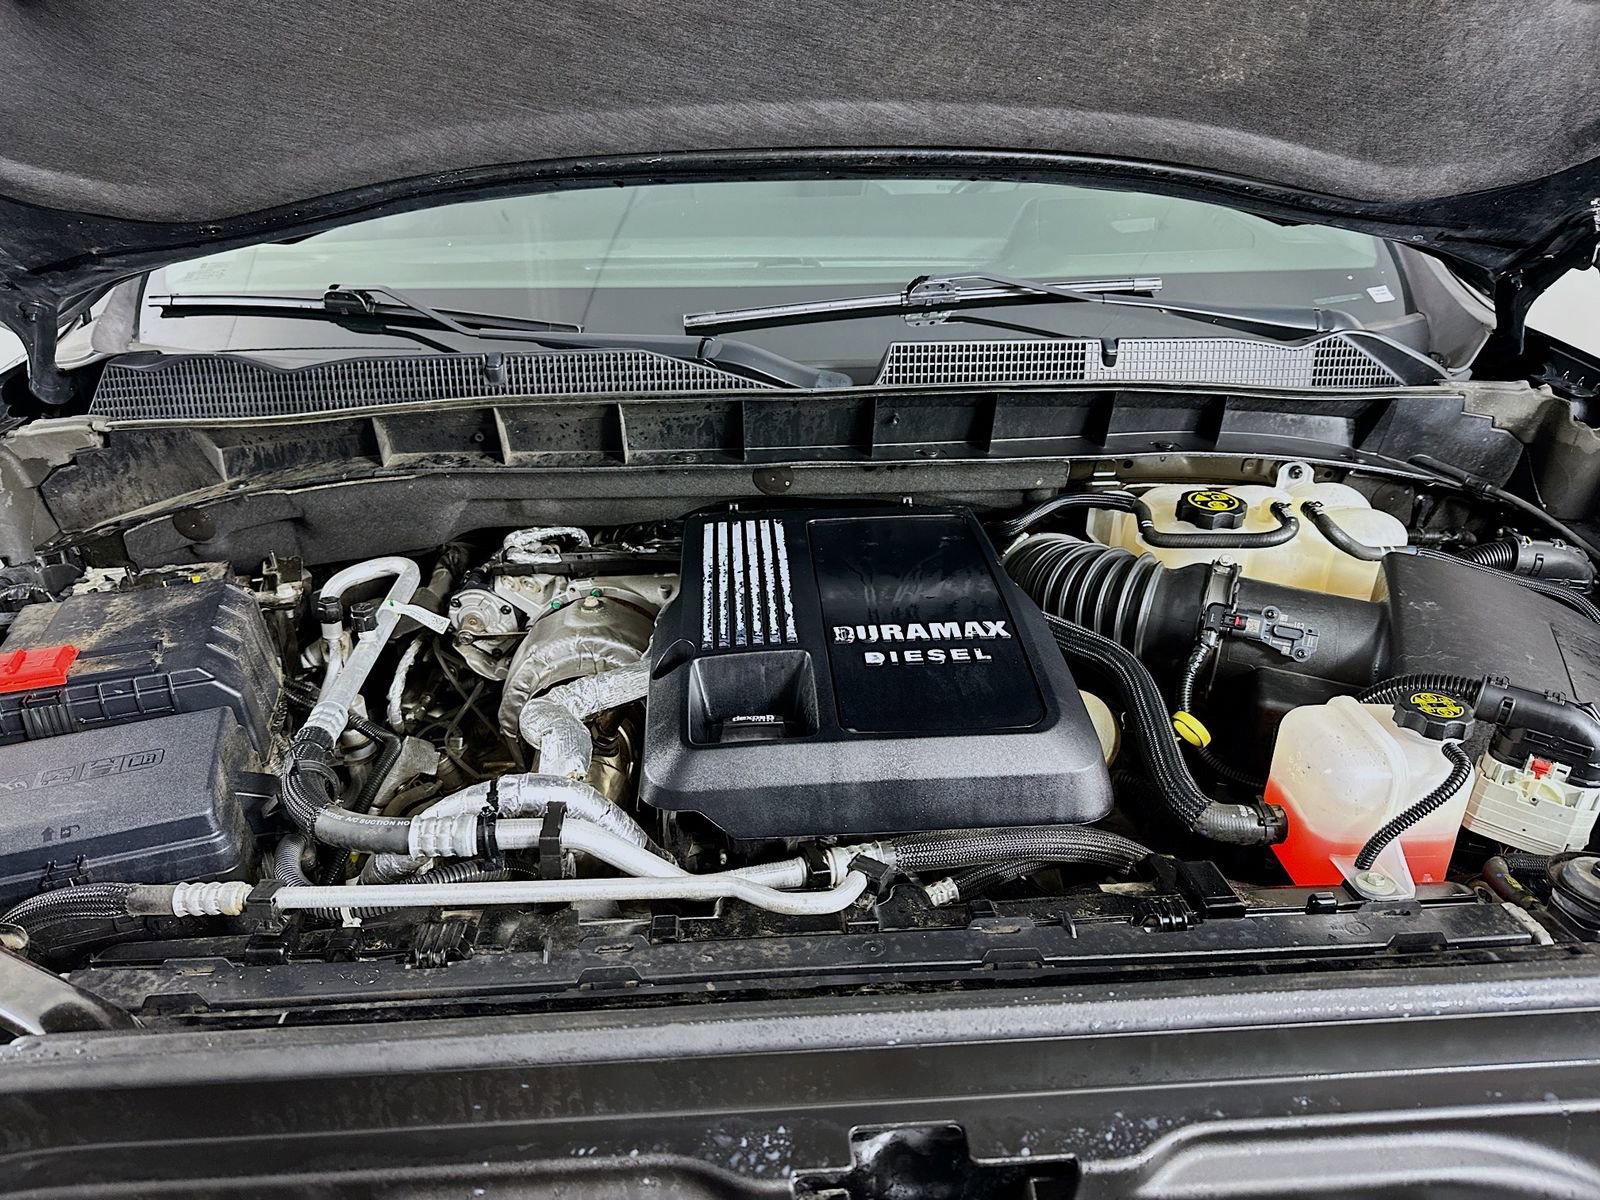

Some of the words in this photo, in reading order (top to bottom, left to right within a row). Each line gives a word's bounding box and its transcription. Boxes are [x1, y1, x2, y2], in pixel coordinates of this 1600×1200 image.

[833, 620, 1012, 644] DURAMAX
[864, 647, 993, 667] DIESEL
[359, 818, 396, 826] SUCTION
